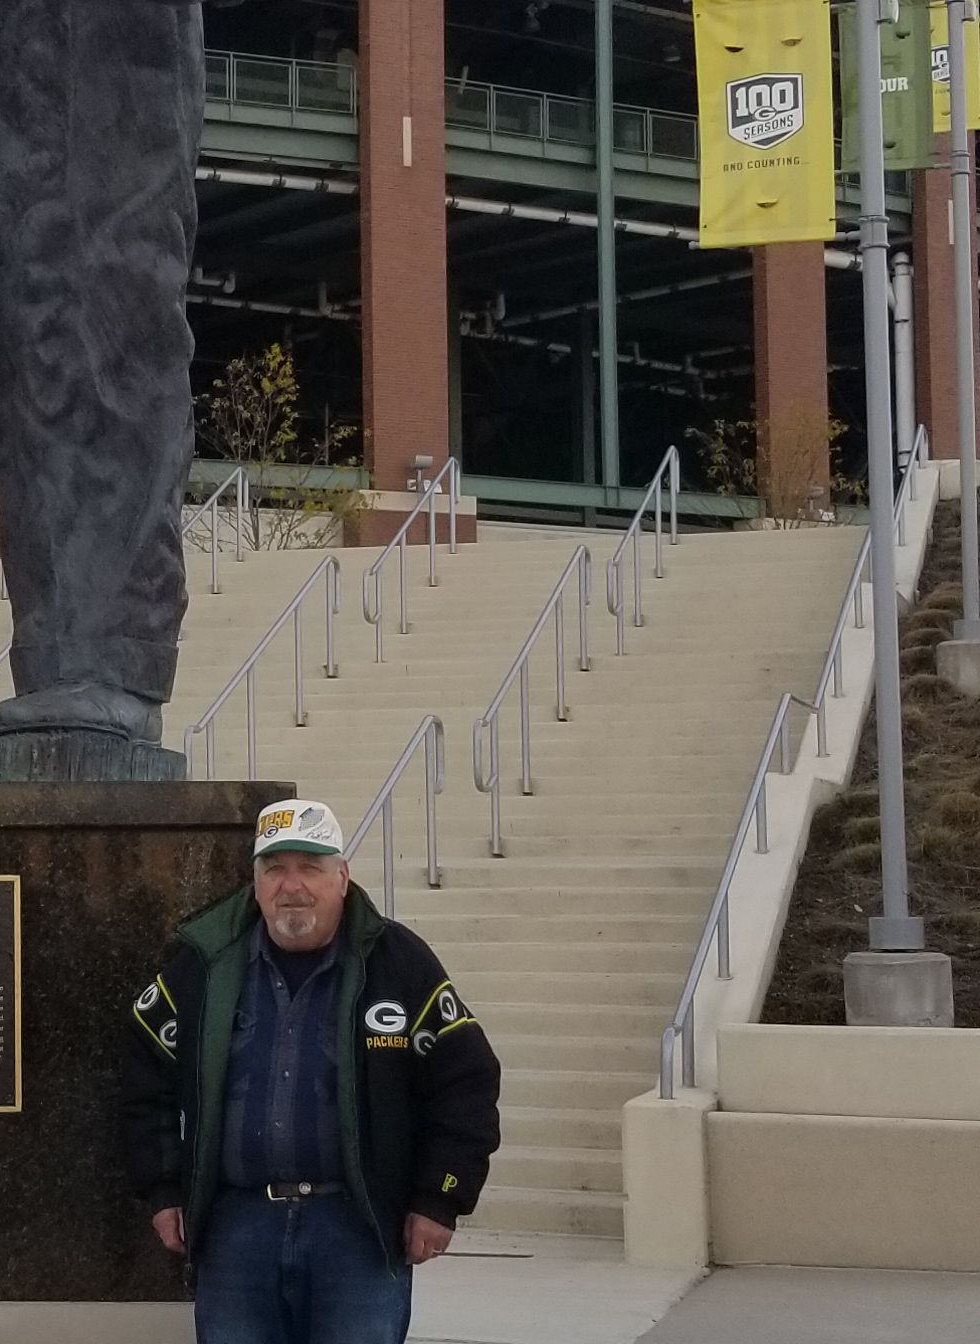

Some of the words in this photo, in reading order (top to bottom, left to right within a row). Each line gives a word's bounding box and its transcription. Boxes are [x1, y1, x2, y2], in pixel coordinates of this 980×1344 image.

[880, 77, 909, 94] OUR
[735, 80, 794, 117] 100
[743, 114, 794, 141] SEASONS
[723, 162, 743, 172] AND
[364, 1000, 407, 1034] G
[366, 1035, 410, 1050] PACKERS
